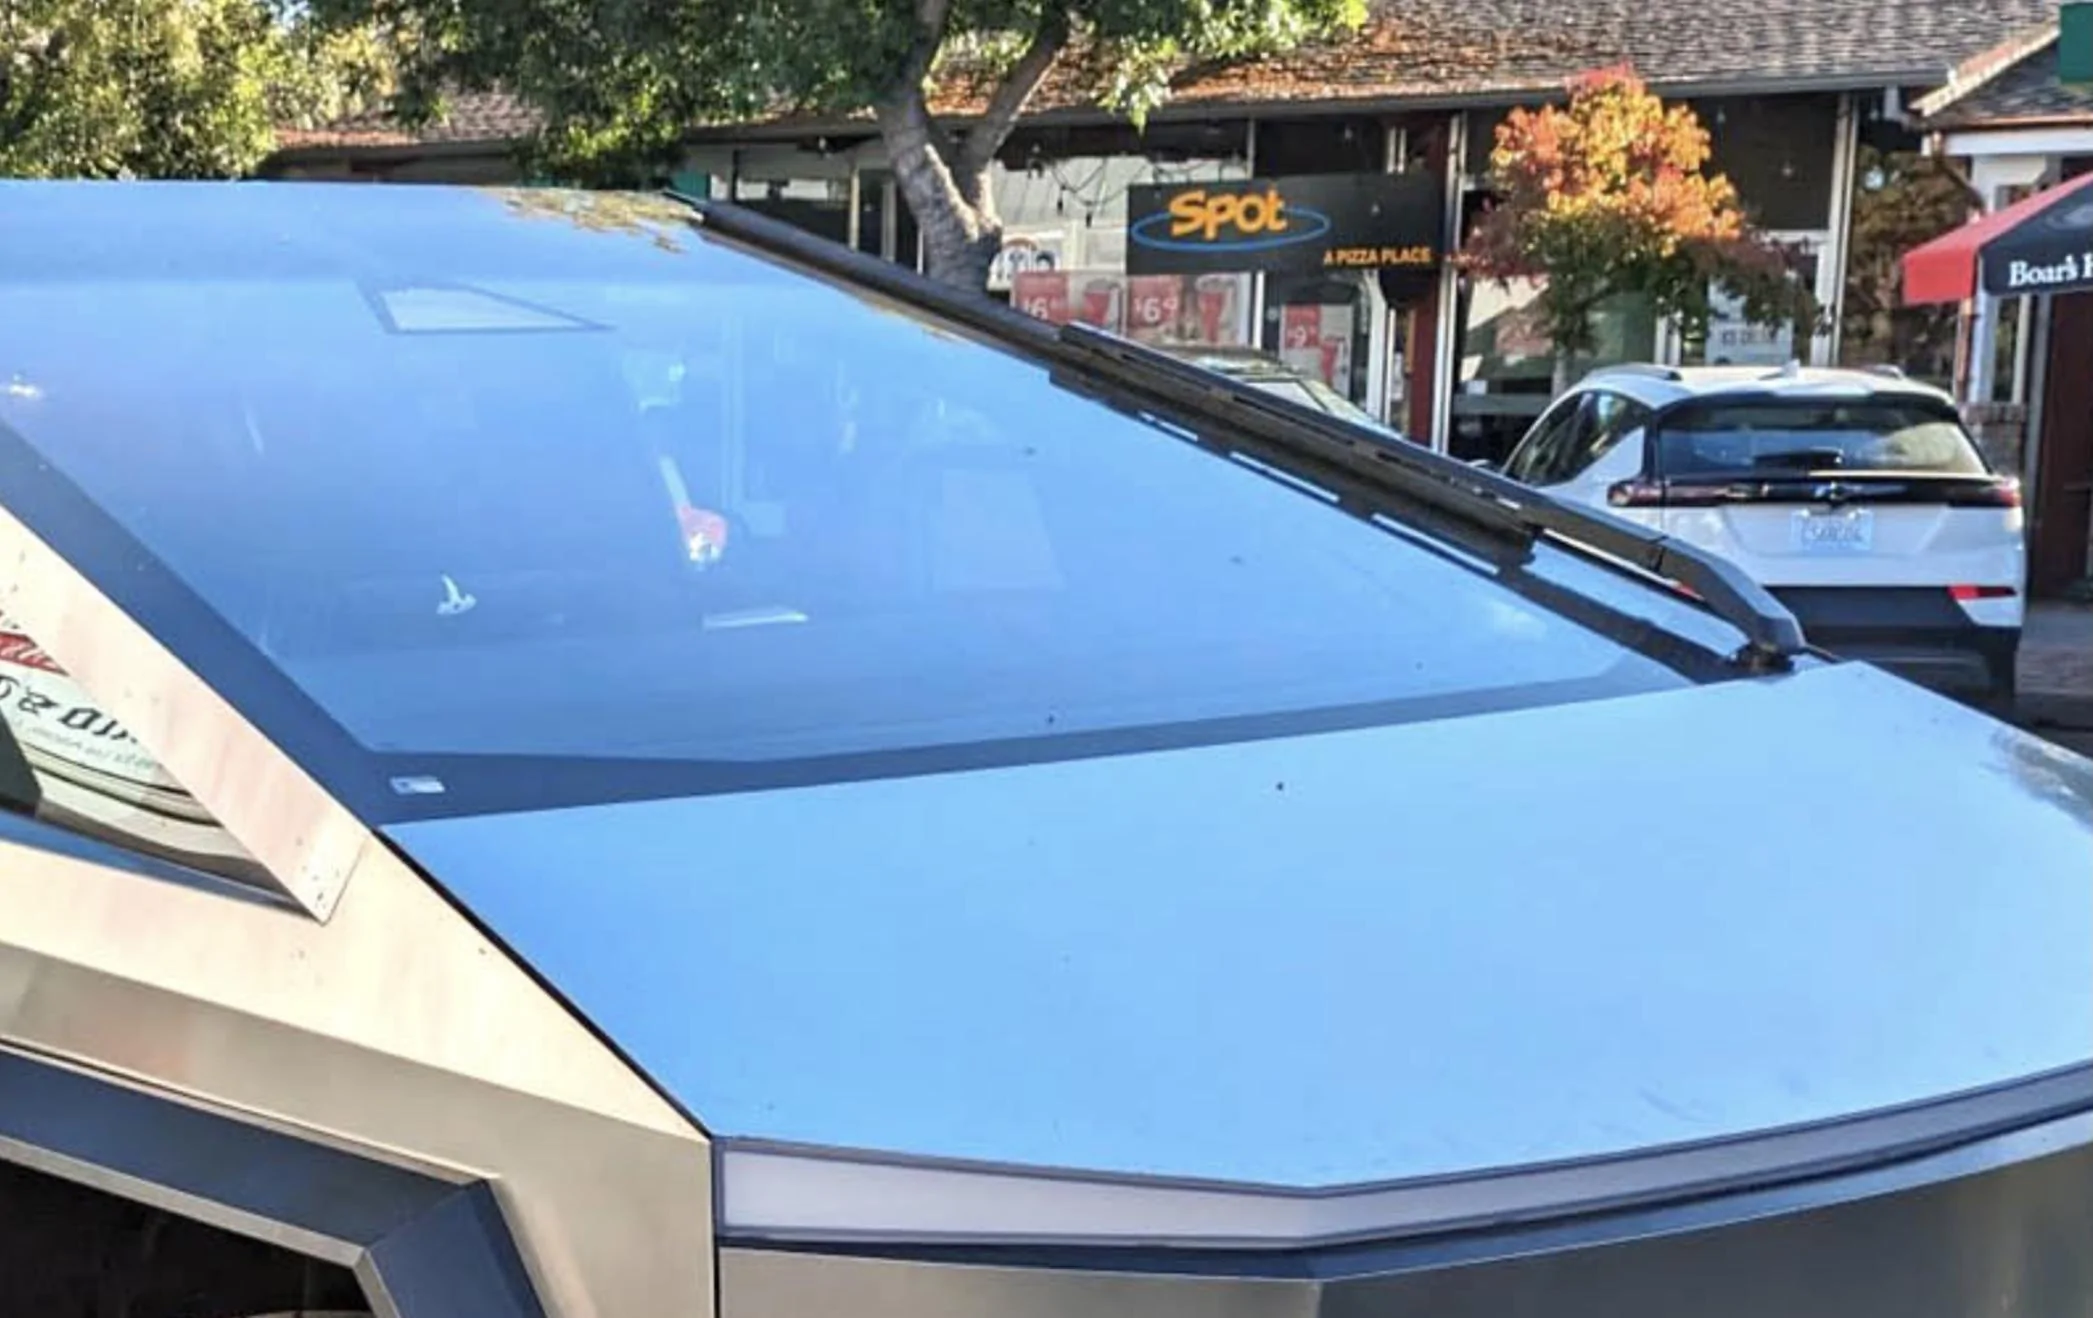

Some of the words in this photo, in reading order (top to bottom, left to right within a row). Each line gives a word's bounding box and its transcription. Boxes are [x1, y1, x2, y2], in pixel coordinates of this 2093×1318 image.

[1169, 186, 1288, 241] Spot
[1323, 249, 1333, 265] A
[1337, 248, 1378, 265] PIZZA
[1381, 246, 1431, 264] PLACE
